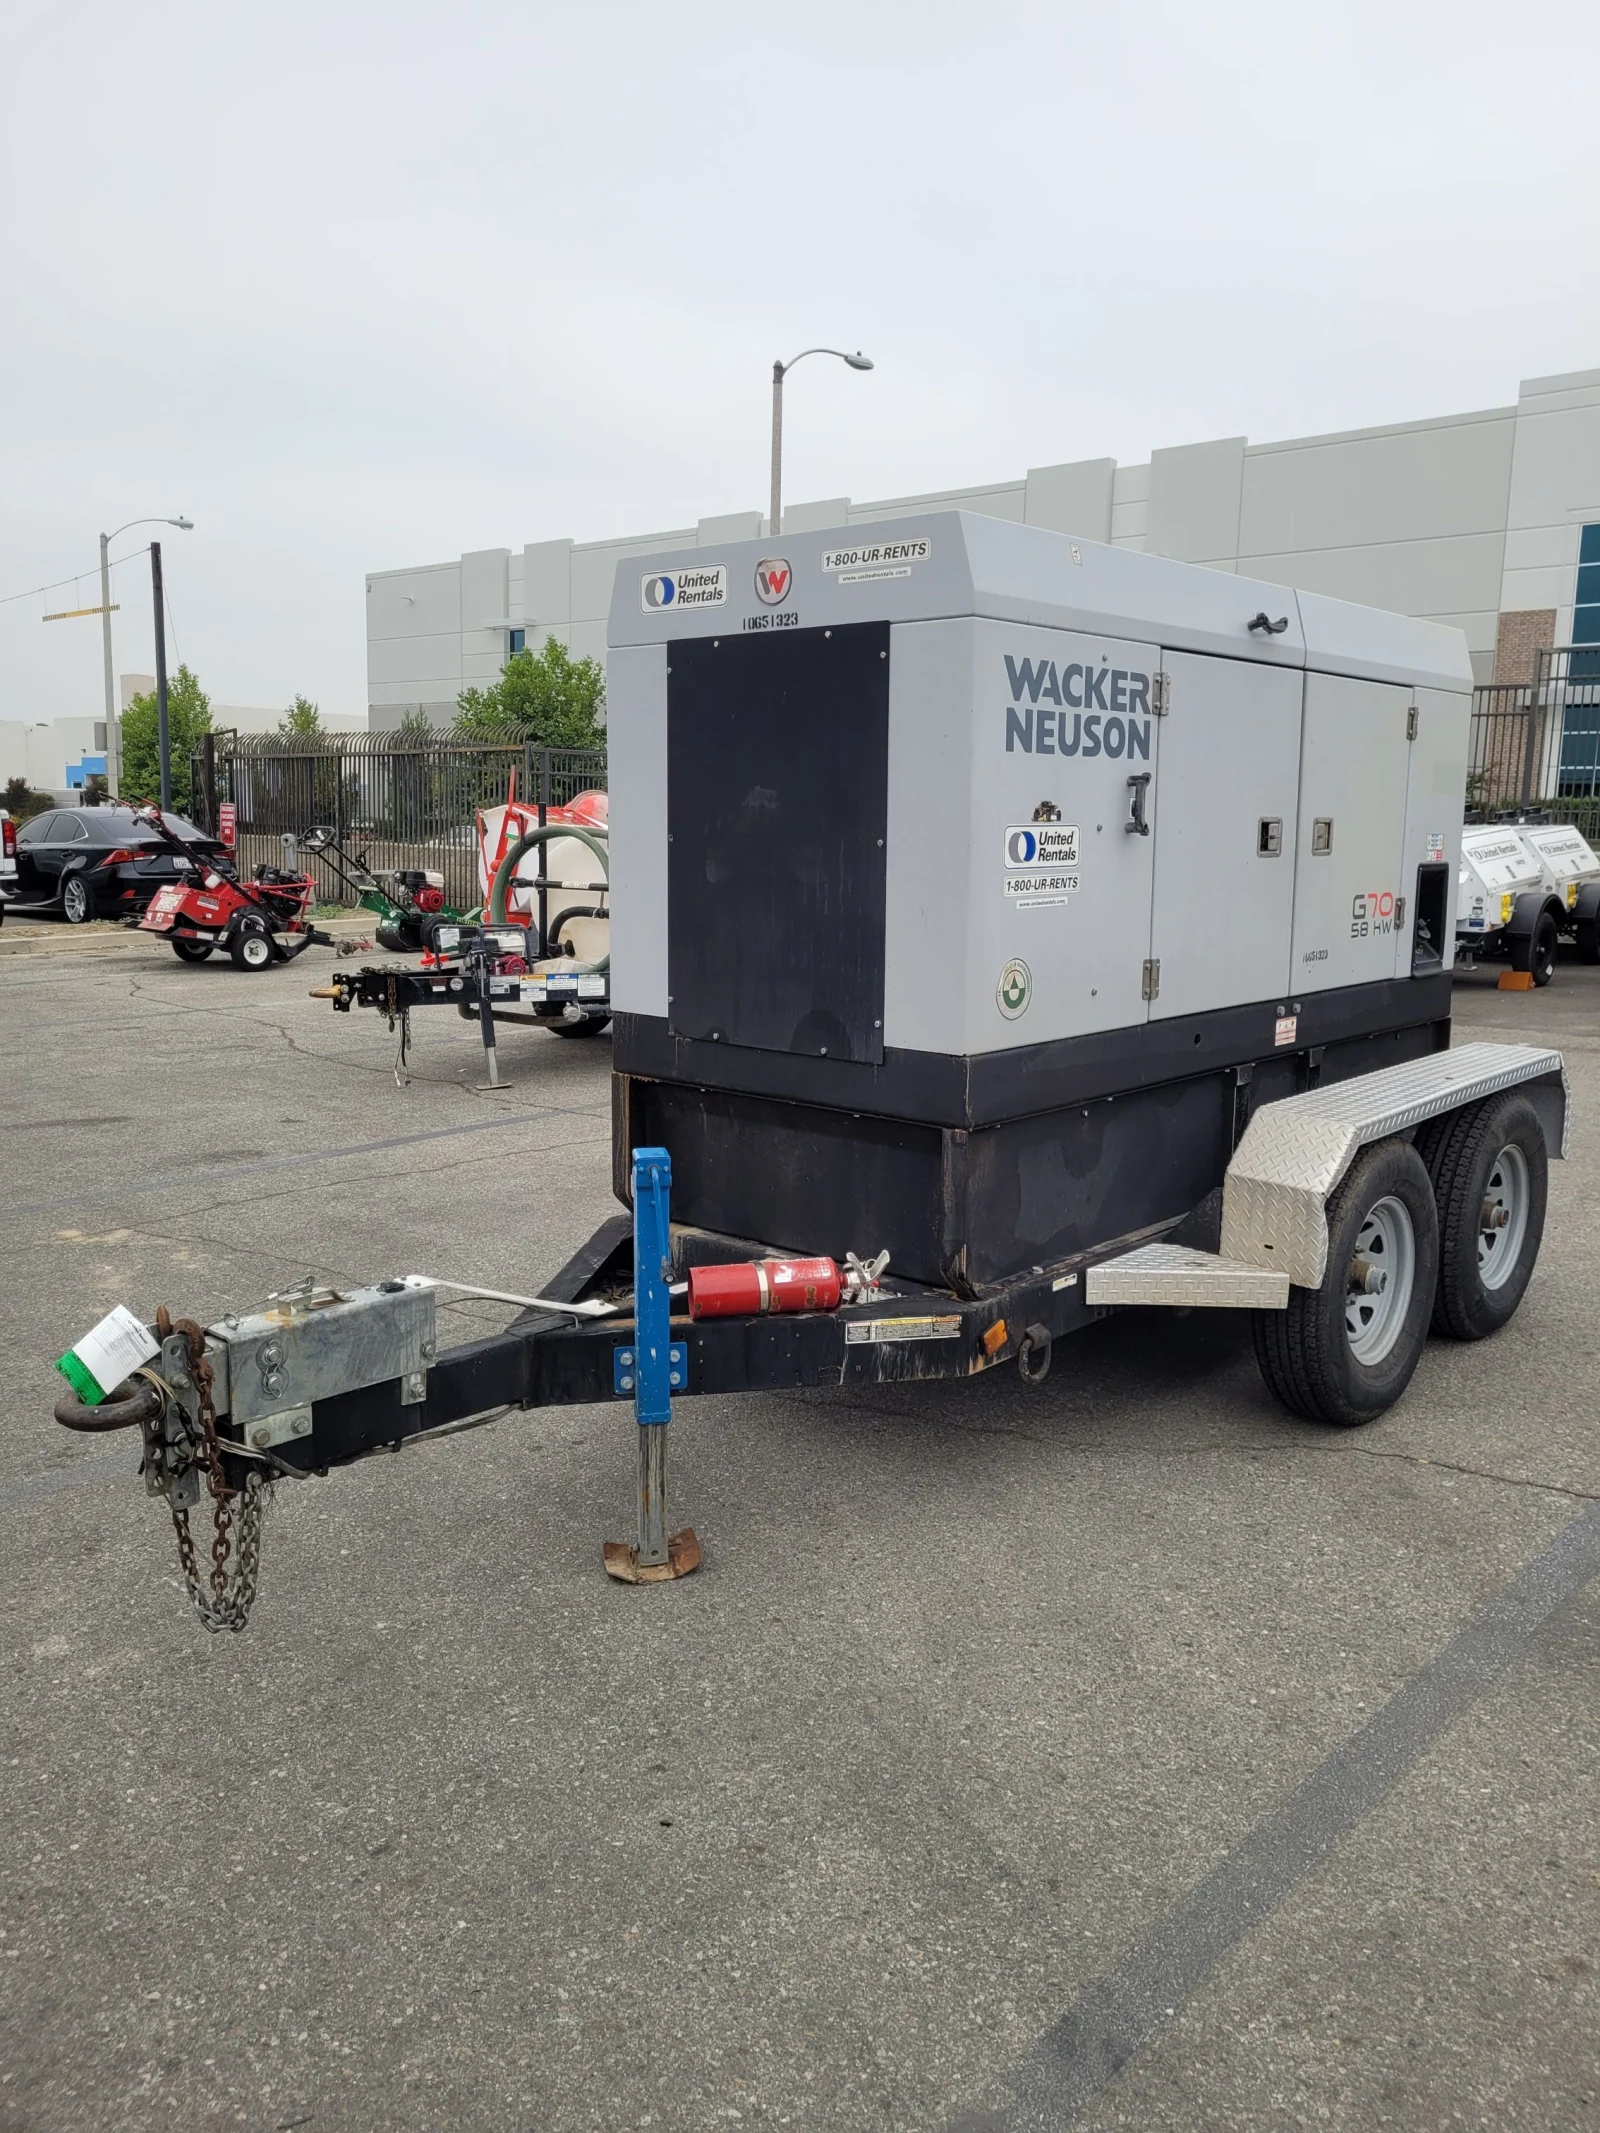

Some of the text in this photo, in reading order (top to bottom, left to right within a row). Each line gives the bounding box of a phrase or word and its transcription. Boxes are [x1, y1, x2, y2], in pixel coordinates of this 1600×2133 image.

[825, 542, 927, 567] 1-800-UR-RENTS
[678, 570, 720, 588] United
[758, 570, 789, 595] W
[842, 569, 908, 582] www.unitedrentals.com
[678, 586, 724, 604] Rentals
[743, 612, 798, 630] 10651323
[1003, 654, 1151, 715] WACKER
[1005, 706, 1151, 761] NEUSON
[1039, 831, 1074, 846] United
[1038, 847, 1077, 861] Rentals
[1006, 876, 1079, 892] 1-800-UR-RENTS
[1352, 892, 1394, 920] G70
[1350, 918, 1393, 938] 58 HW
